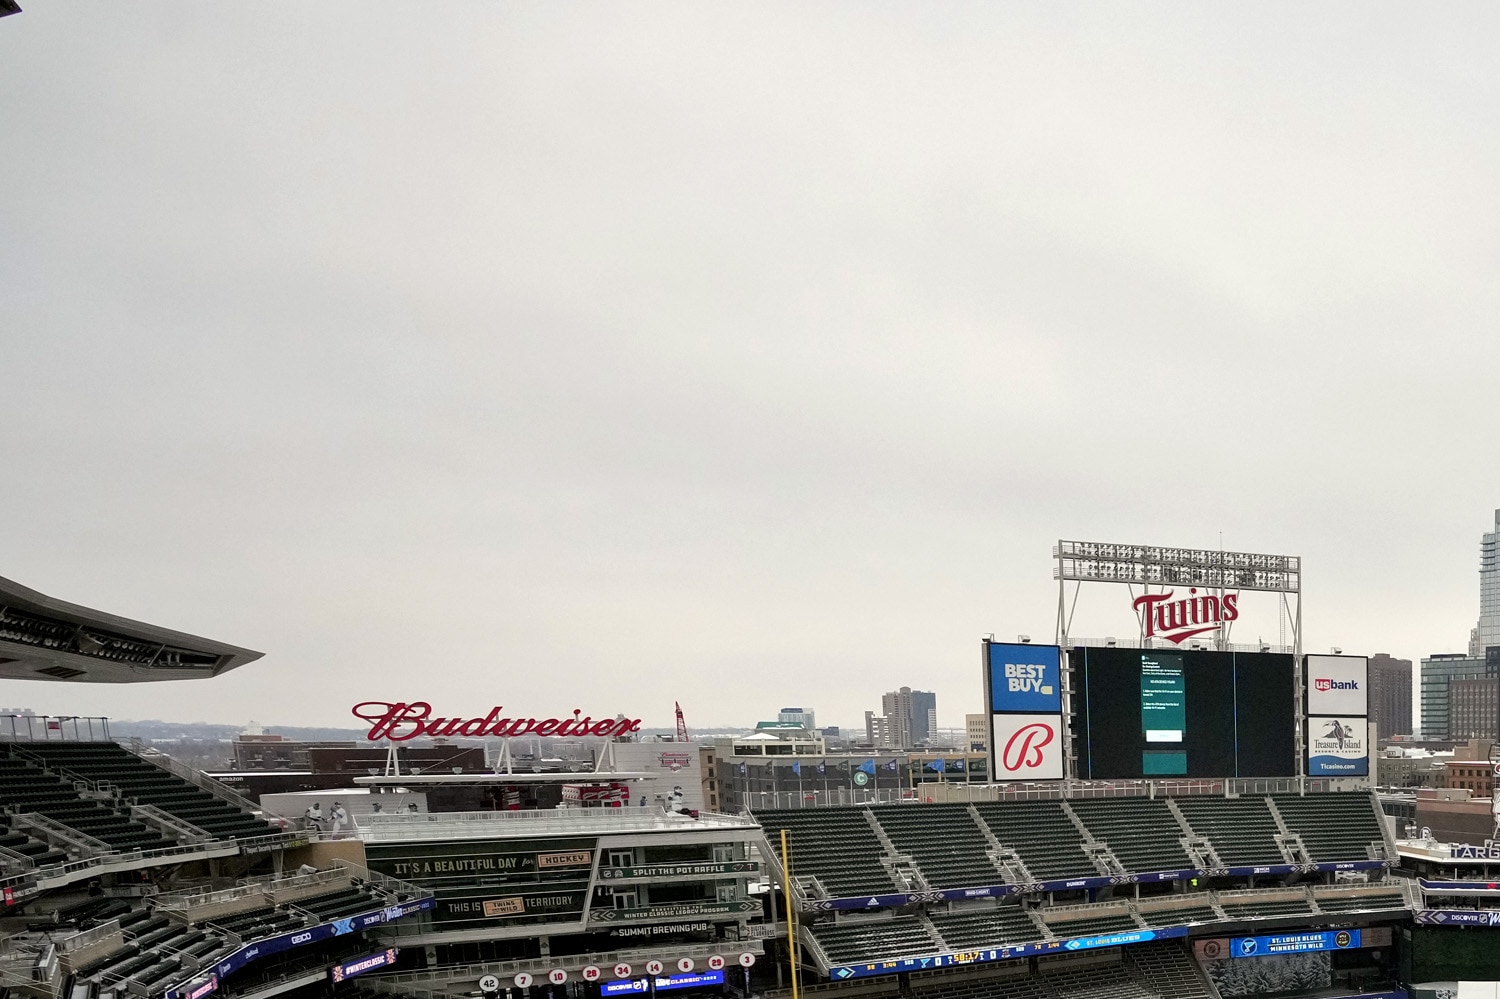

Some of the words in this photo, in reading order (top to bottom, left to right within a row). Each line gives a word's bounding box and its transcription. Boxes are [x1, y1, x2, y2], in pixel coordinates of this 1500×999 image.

[1133, 588, 1239, 638] Twins
[1005, 664, 1045, 678] BEST
[1009, 678, 1042, 692] BUY
[352, 701, 641, 741] Budweiser
[1314, 740, 1338, 749] Treasure
[1344, 740, 1361, 749] Island
[395, 863, 420, 874] IT'S
[424, 862, 431, 872] A
[434, 858, 497, 872] BEAUTIFUL
[499, 858, 517, 869] DAY
[545, 854, 584, 865] HOCKEY
[632, 868, 656, 876] SPLIT
[676, 866, 692, 874] POT
[449, 902, 470, 913] THIS
[472, 902, 481, 911] IS
[525, 896, 572, 908] TERRITORY
[364, 915, 380, 925] DISCOVER
[384, 907, 403, 923] Winter
[403, 905, 420, 915] CLASSIC
[649, 910, 674, 918] CLASSIC
[676, 908, 699, 916] LEGACY
[700, 906, 730, 914] PROGRAM
[619, 927, 652, 937] SUMMIT
[653, 925, 690, 935] BREWING
[692, 923, 707, 932] PUB
[292, 932, 312, 944] GEICO
[1111, 934, 1140, 943] BLUES
[1270, 944, 1307, 952] MINNESOTA
[684, 961, 688, 969] 6
[712, 958, 722, 967] 29
[745, 956, 750, 964] 3
[346, 956, 384, 975] #WINTERCLASSIC
[618, 966, 628, 975] 34
[650, 963, 659, 972] 14
[554, 973, 564, 982] 10
[586, 970, 597, 978] 28
[483, 979, 494, 988] 42
[521, 976, 526, 986] 7
[670, 976, 702, 985] CLASSIC
